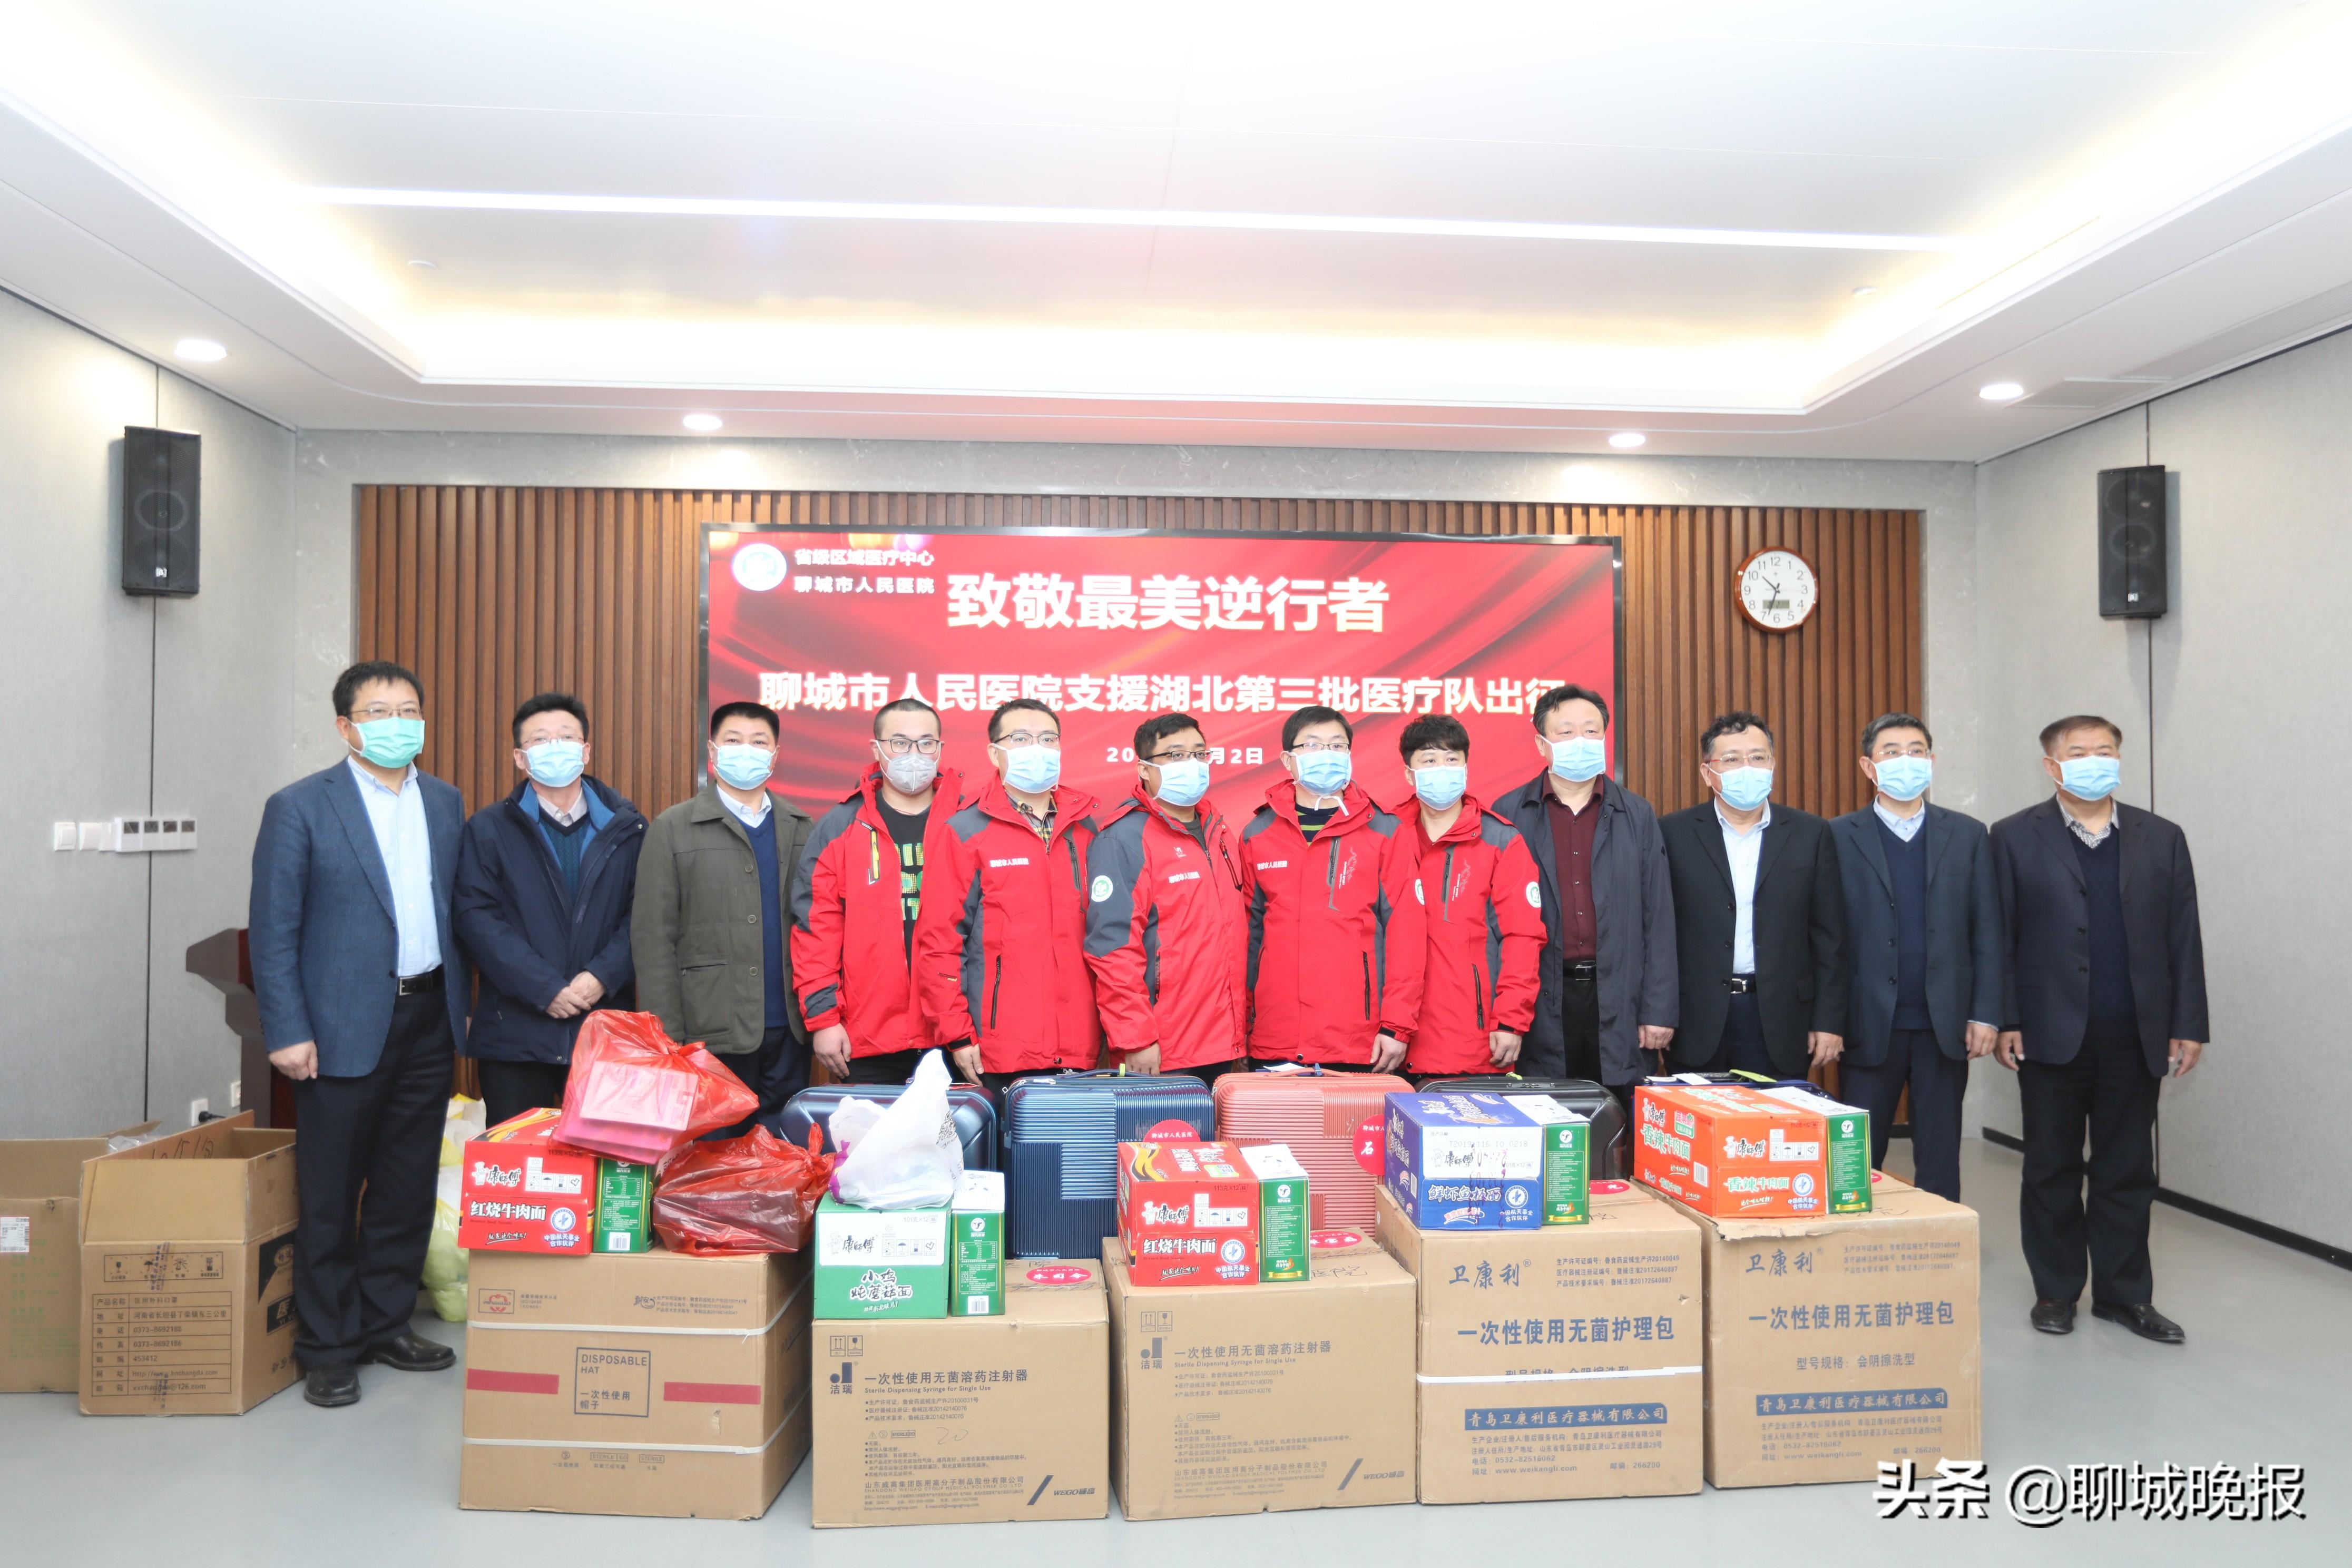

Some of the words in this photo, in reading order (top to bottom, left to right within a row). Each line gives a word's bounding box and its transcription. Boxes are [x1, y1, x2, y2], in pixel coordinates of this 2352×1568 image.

[794, 549, 934, 567] 省级区域医疗中心
[1771, 557, 1780, 566] 12
[1758, 561, 1766, 570] 11
[1788, 561, 1791, 570] 1
[1748, 571, 1758, 580] 10
[1797, 571, 1804, 580] 2
[794, 576, 935, 594] 聊城市人民医院
[1744, 586, 1751, 595] 9
[1801, 585, 1808, 594] 3
[947, 572, 1390, 632] 致敬最美逆行者
[1749, 601, 1756, 610] 8
[1797, 600, 1804, 609] 4
[1761, 611, 1767, 621] 7
[1773, 614, 1780, 623] 6
[1788, 611, 1794, 621] 5
[1151, 1130, 1193, 1139] 聊城市人民医院
[1640, 1123, 1690, 1161] 香辣牛肉面
[1361, 1141, 1374, 1155] 石
[1723, 1176, 1790, 1192] 香辣牛肉面
[1428, 1184, 1502, 1202] 鲜虾鱼板面
[470, 1201, 547, 1221] 红烧牛肉面
[1143, 1238, 1217, 1254] 红烧牛肉面
[1745, 1248, 1814, 1277] 卫康利
[862, 1269, 896, 1283] 小鸡
[1449, 1259, 1520, 1290] 卫康利
[96, 1298, 126, 1306] 产品名称
[1749, 1300, 1954, 1330] 一次性使用无菌护理包
[1458, 1315, 1674, 1346] 一次性使用无菌护理包
[1174, 1340, 1331, 1358] 一次性使用无菌溶药注射器
[581, 1354, 648, 1367] DISPOSABLE
[1140, 1359, 1163, 1369] 洁瑞
[1196, 1360, 1229, 1368] Dispensing
[1230, 1359, 1252, 1367] Syringe
[581, 1365, 600, 1374] HAT
[865, 1369, 1028, 1385] 一次性使用无菌溶药注射器
[830, 1384, 852, 1394] 洁瑞
[959, 1385, 978, 1393] Single
[580, 1390, 631, 1402] 一次性使用
[580, 1399, 600, 1410] 帽子
[1760, 1392, 1946, 1413] 青岛卫康利医疗器械有限公司
[1468, 1406, 1664, 1428] 青岛卫康利医疗器械有限公司
